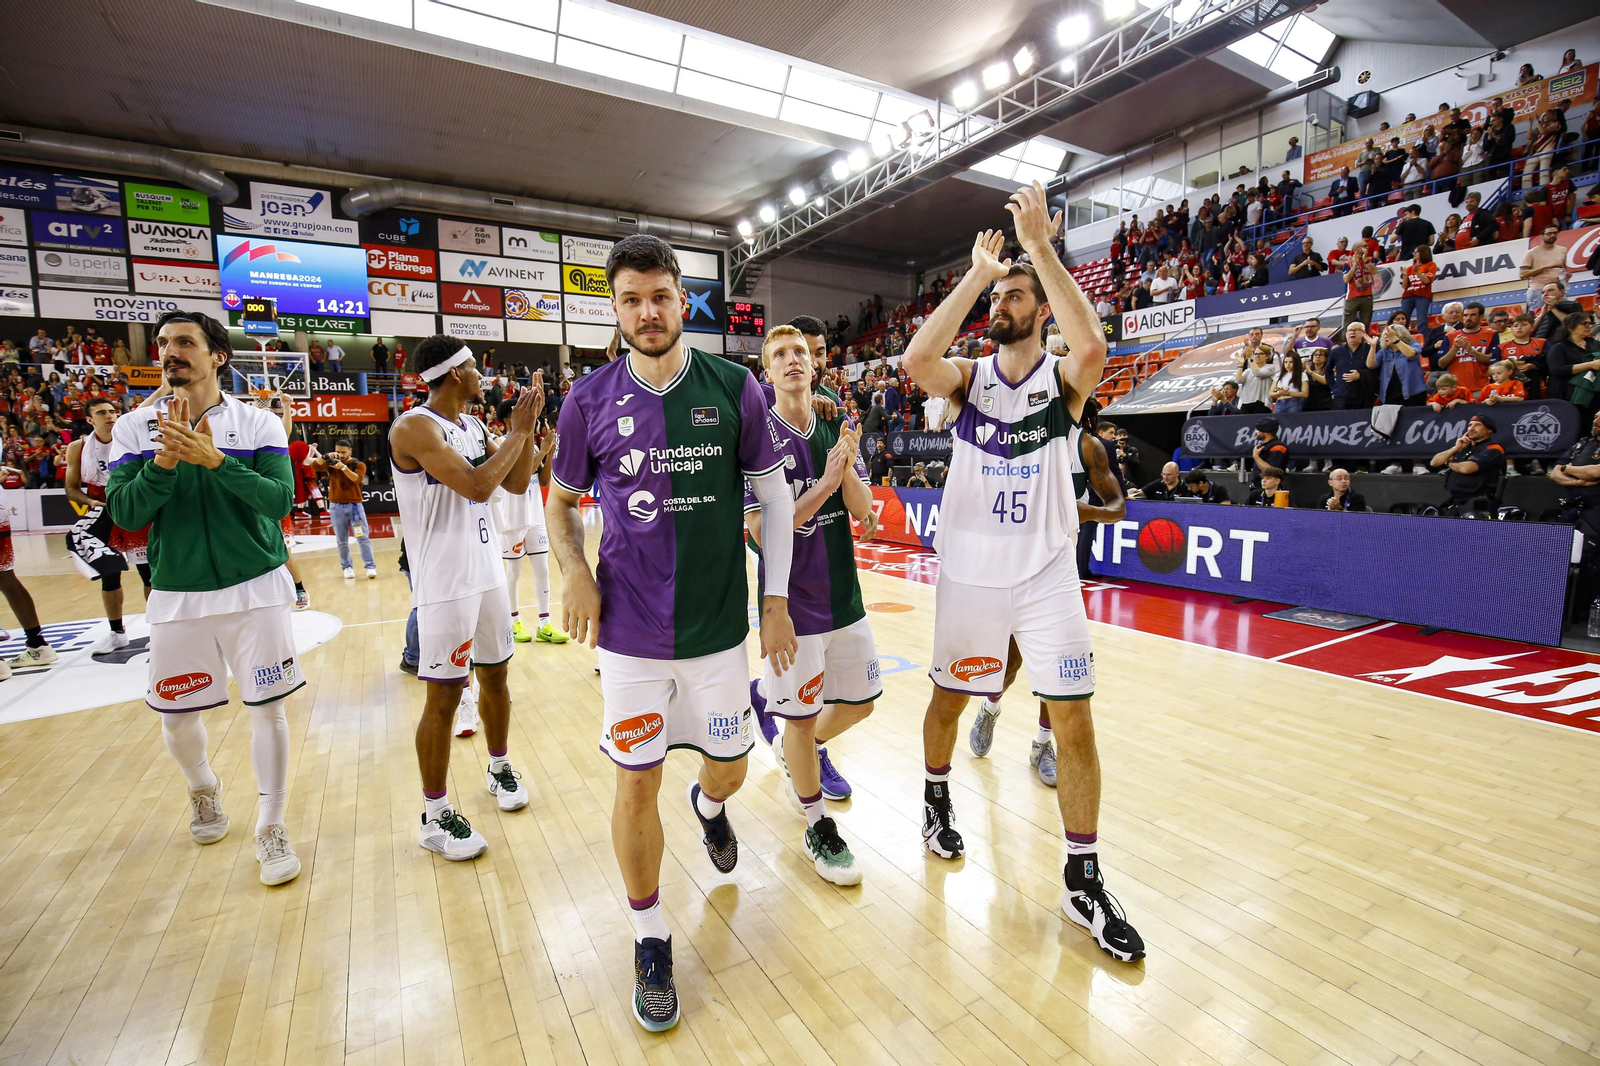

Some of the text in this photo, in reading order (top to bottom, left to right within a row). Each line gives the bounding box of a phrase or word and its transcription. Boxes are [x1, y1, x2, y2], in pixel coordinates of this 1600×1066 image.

[1570, 85, 1584, 94] FM
[135, 192, 172, 201] BUSQUEM
[263, 218, 353, 234] www.grupjoan.com
[378, 232, 406, 242] CUBE
[143, 245, 181, 254] expert
[387, 250, 419, 263] Plana
[487, 266, 545, 281] AVINENT
[367, 280, 434, 303] GCT plus
[1240, 290, 1292, 304] VOLVO
[93, 296, 178, 312] movento
[316, 298, 366, 315] 14:21
[454, 302, 490, 312] montepio
[95, 308, 150, 321] sarsa
[588, 308, 605, 316] GOL
[1139, 305, 1195, 331] AIGNEP
[305, 319, 356, 330] CLARET
[450, 328, 475, 336] sarsa
[312, 424, 325, 436] La
[997, 425, 1048, 445] Unicaja
[1516, 423, 1559, 435] BAXI
[1185, 433, 1209, 442] BAXI
[648, 442, 723, 461] Fundación
[650, 458, 704, 475] Unicaja
[663, 495, 717, 506] COSTA DEL SOL
[992, 490, 1028, 524] 45
[663, 505, 694, 513] MÁLAGA
[478, 517, 489, 544] 6
[953, 658, 1001, 676] famadesa
[1063, 653, 1087, 668] má
[258, 662, 281, 678] má
[1059, 665, 1088, 681] laga
[158, 675, 210, 695] famadesa
[255, 673, 282, 687] laga
[712, 711, 739, 727] má
[613, 716, 662, 742] famadesa
[708, 722, 739, 740] laga
